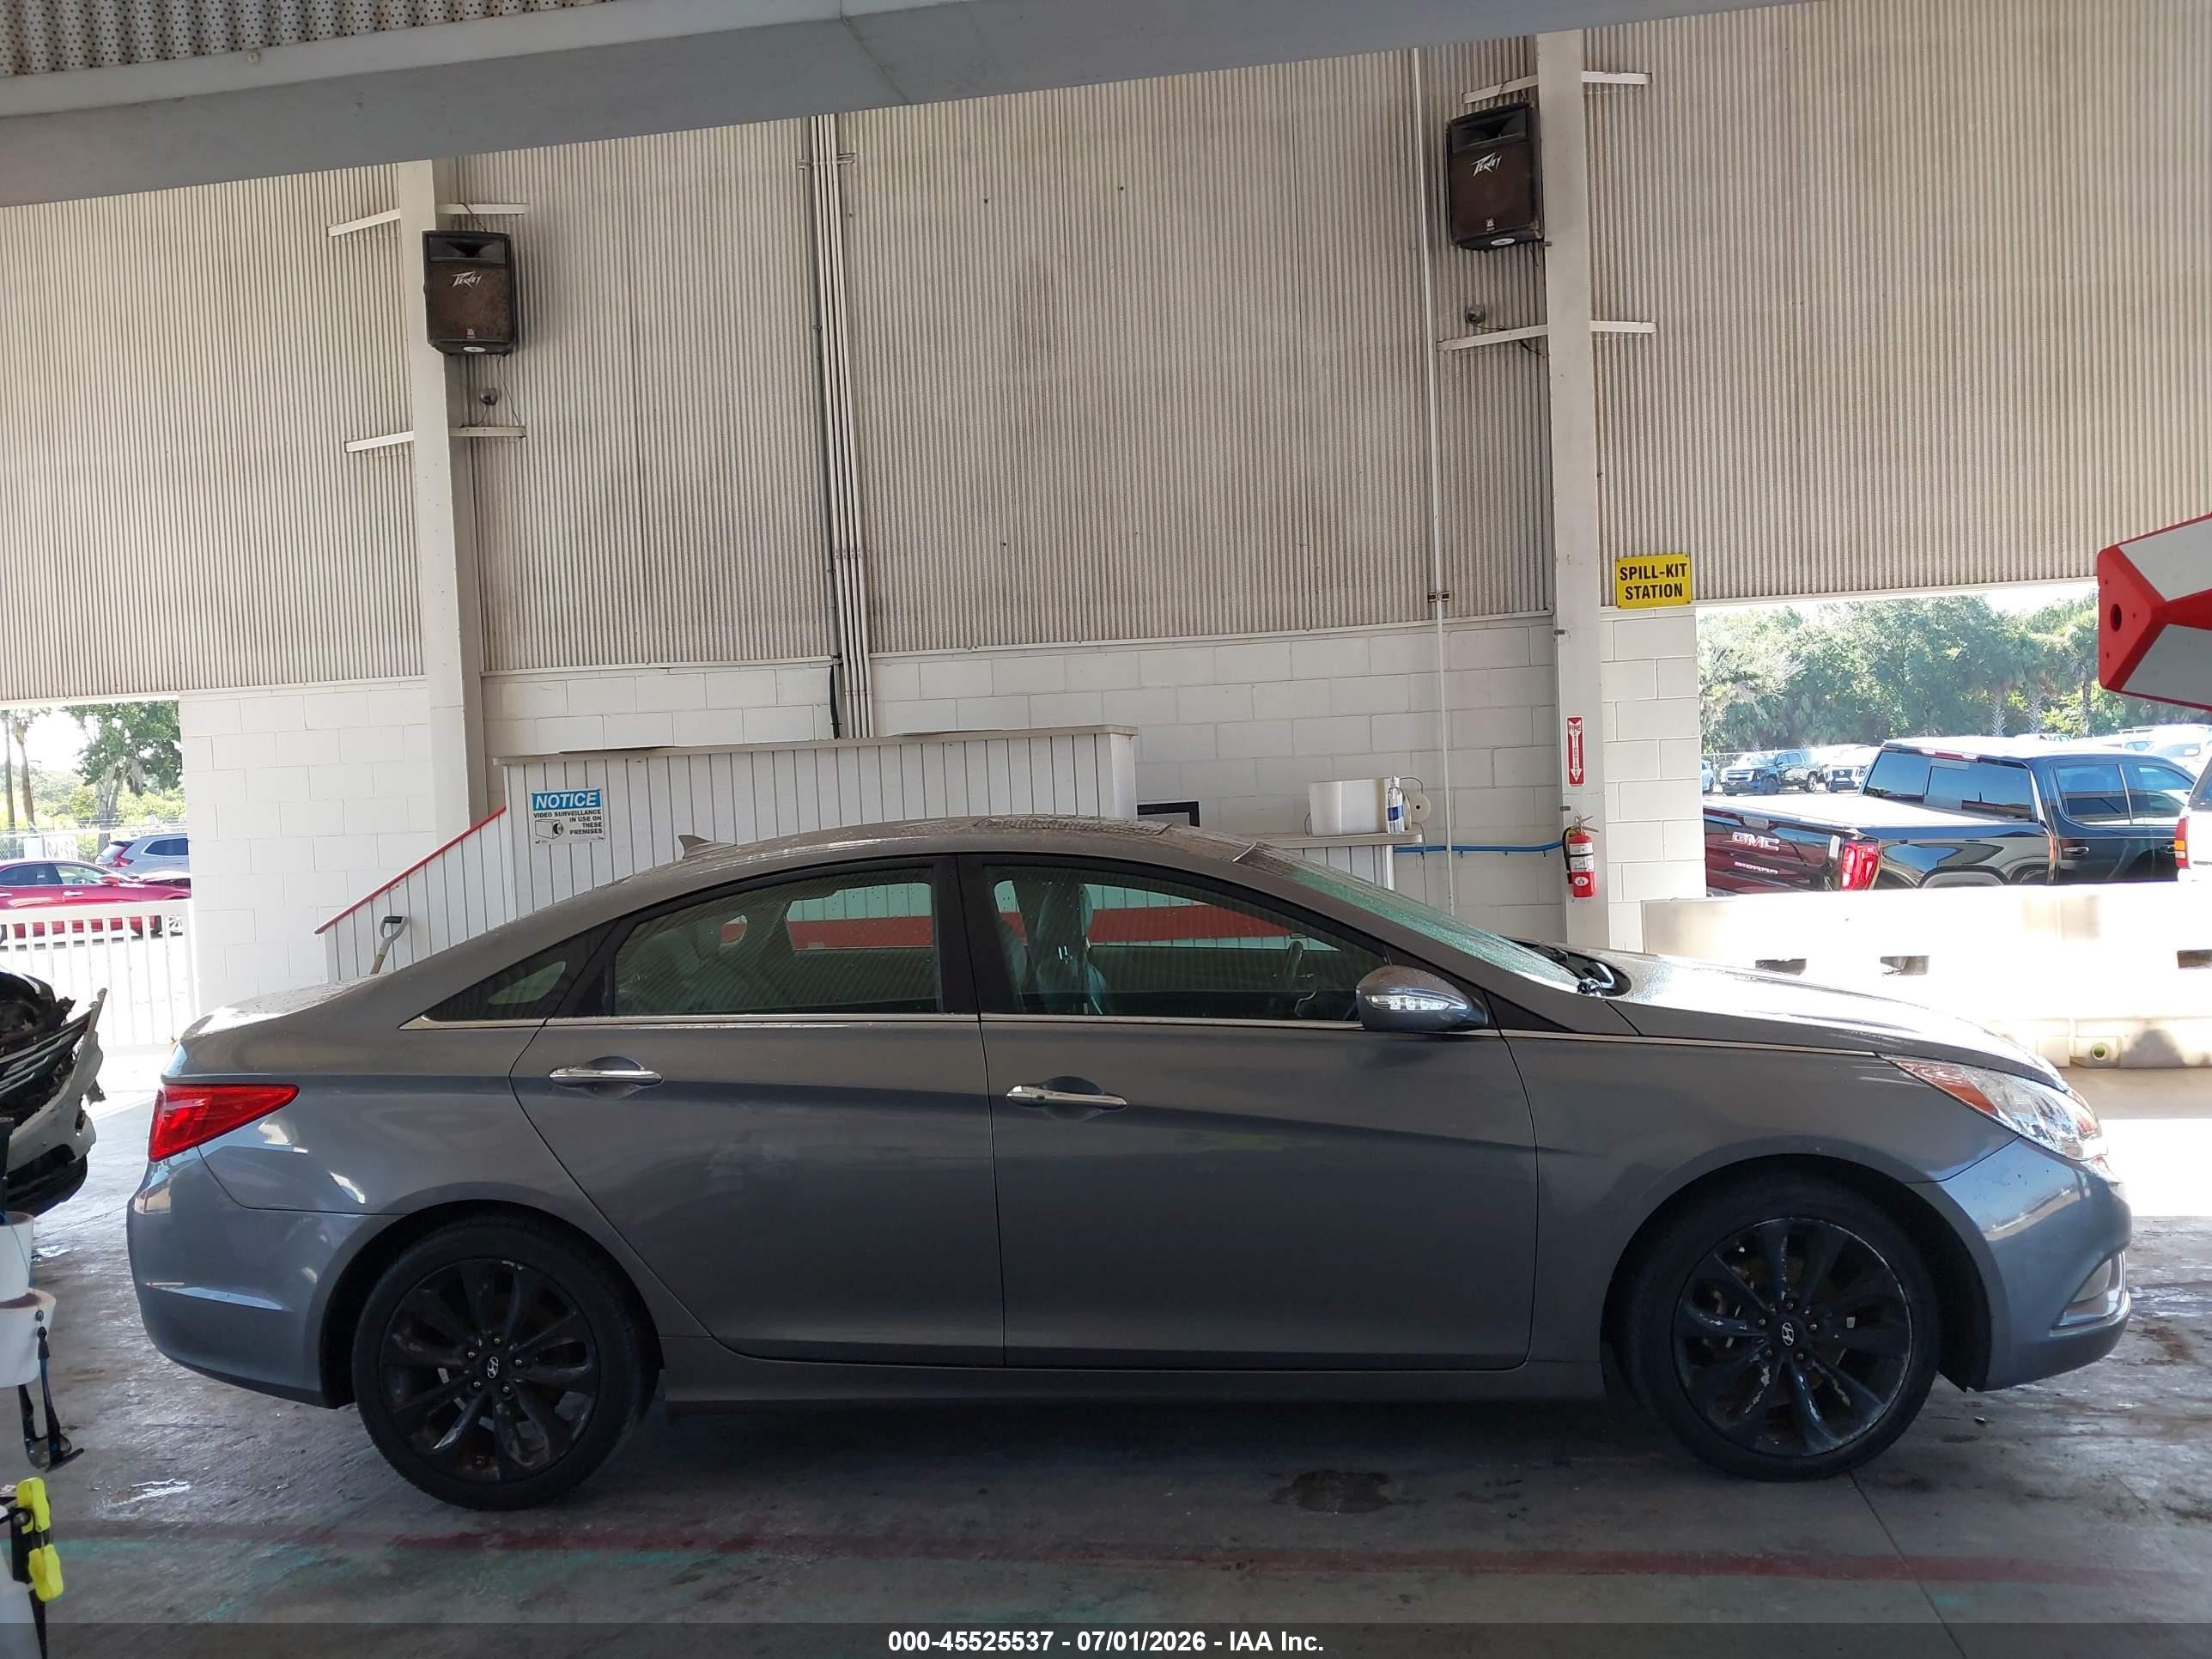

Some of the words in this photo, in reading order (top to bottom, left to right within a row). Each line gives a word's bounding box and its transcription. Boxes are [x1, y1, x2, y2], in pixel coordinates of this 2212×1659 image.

[1620, 562, 1687, 581] SPILL-KIT
[1625, 583, 1683, 600] STATION
[535, 792, 598, 809] NOTICE
[554, 809, 601, 817] SURVEILLANCE
[1732, 831, 1780, 851] GMC
